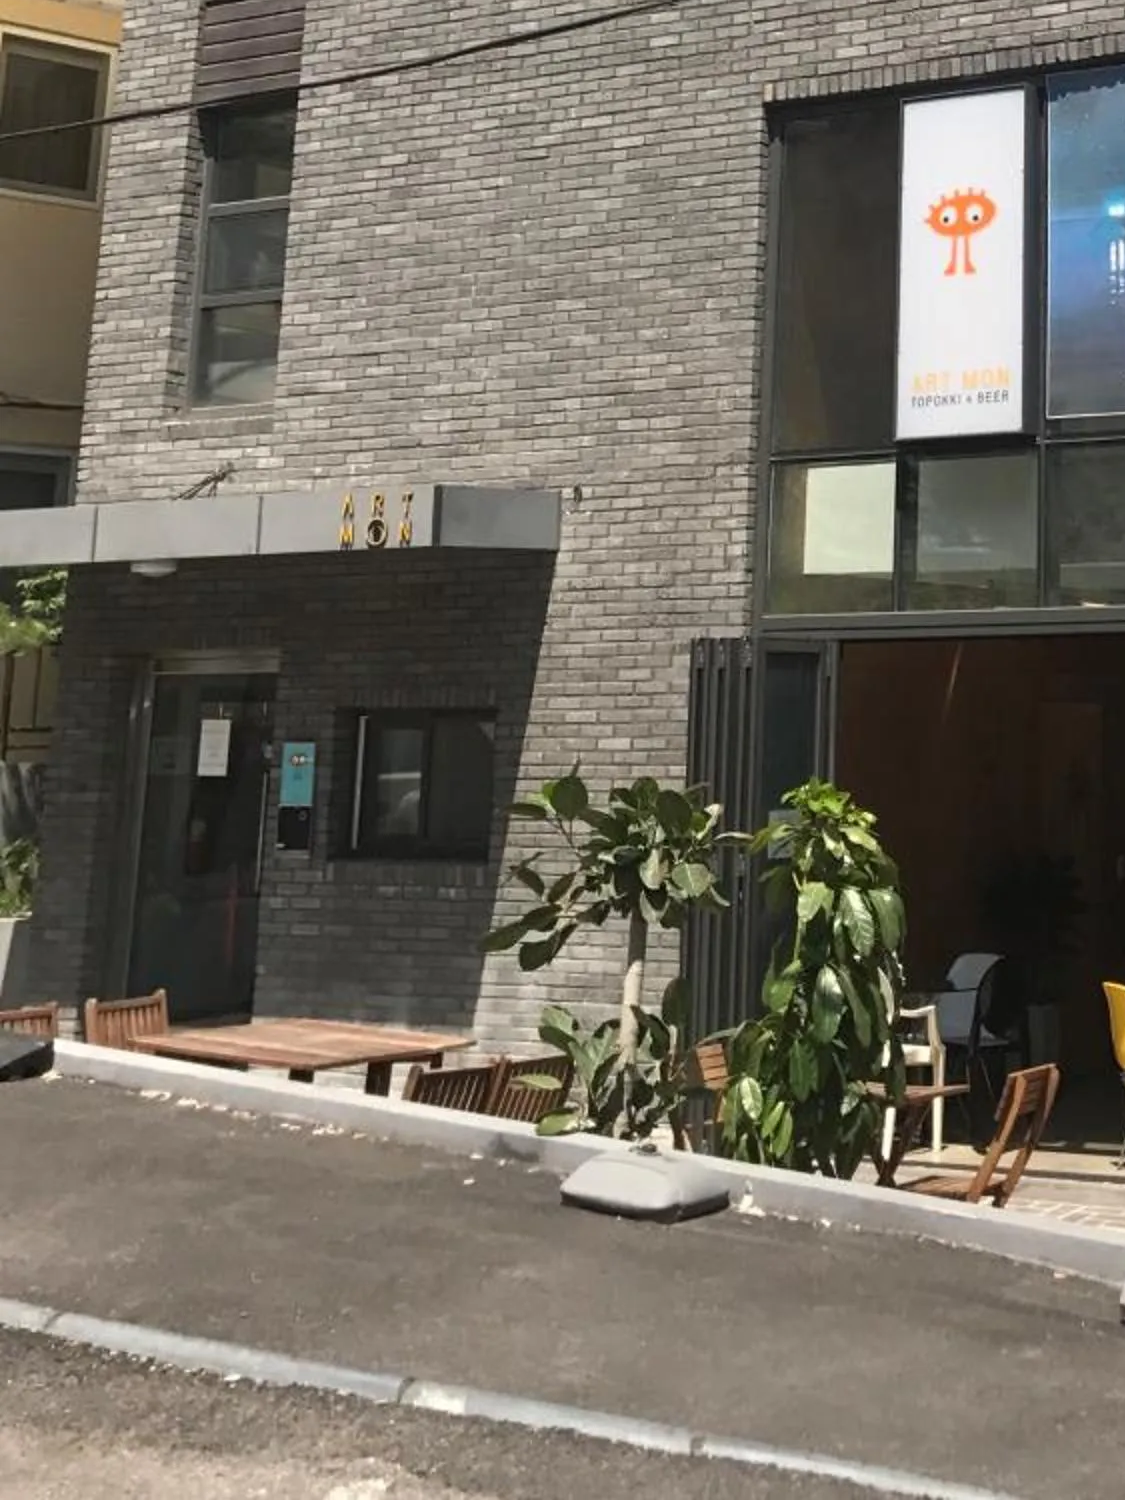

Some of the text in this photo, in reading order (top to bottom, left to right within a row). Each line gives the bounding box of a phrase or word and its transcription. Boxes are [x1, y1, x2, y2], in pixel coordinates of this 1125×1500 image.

[911, 394, 961, 408] TOPOKKI
[977, 389, 1009, 404] BEER
[341, 491, 415, 519] ART
